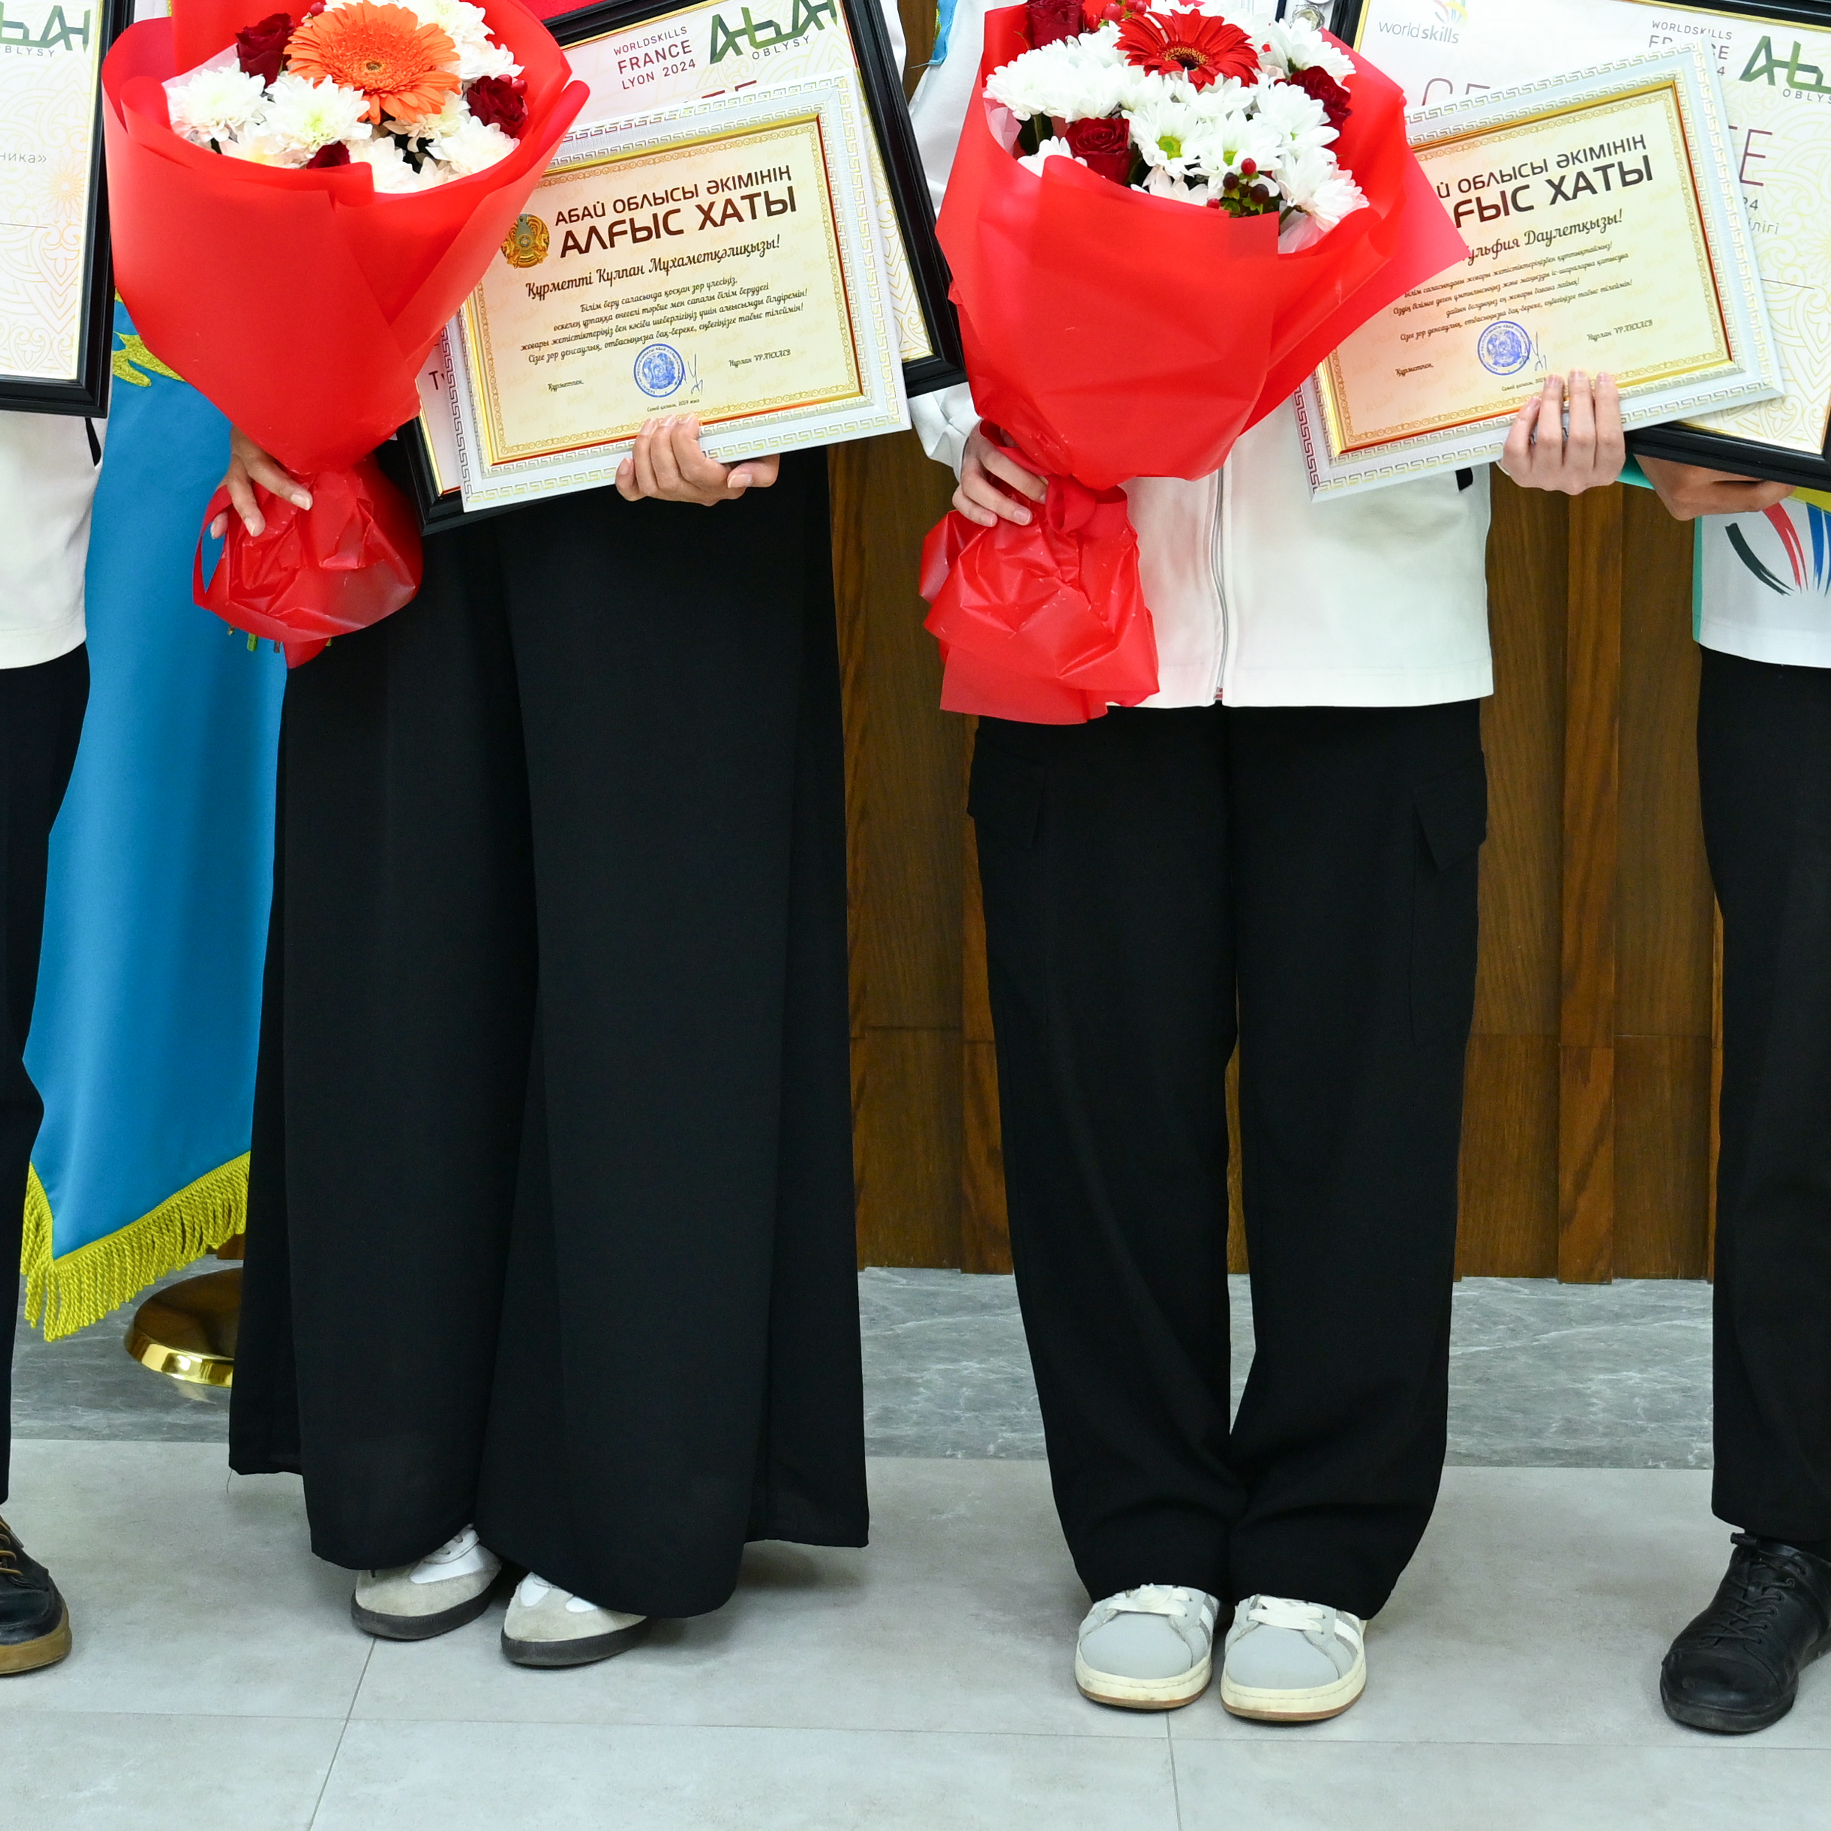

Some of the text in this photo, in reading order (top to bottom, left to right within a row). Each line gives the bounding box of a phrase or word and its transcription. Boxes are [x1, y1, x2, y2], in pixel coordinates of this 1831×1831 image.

[613, 25, 688, 57] WORLDSKILLS
[751, 34, 811, 61] OBLYSY
[1378, 21, 1460, 45] worldskills
[617, 39, 693, 75] FRANCE
[621, 58, 697, 90] LYON 2024
[1456, 157, 1549, 194] ОБЛЫСЫ
[1554, 132, 1647, 169] ӘКІМІНІҢ
[553, 163, 792, 227] АБАЙ ОБЛЫСЫ ӘКІМІНІҢ
[1452, 182, 1535, 229] ҒЫС
[1543, 153, 1653, 206] ХАТЫ
[558, 184, 797, 259] АЛҒЫС ХАТЫ
[1522, 207, 1623, 248] Даулетқызы!
[524, 270, 594, 302] Құрметті
[594, 264, 646, 288] Күлпан
